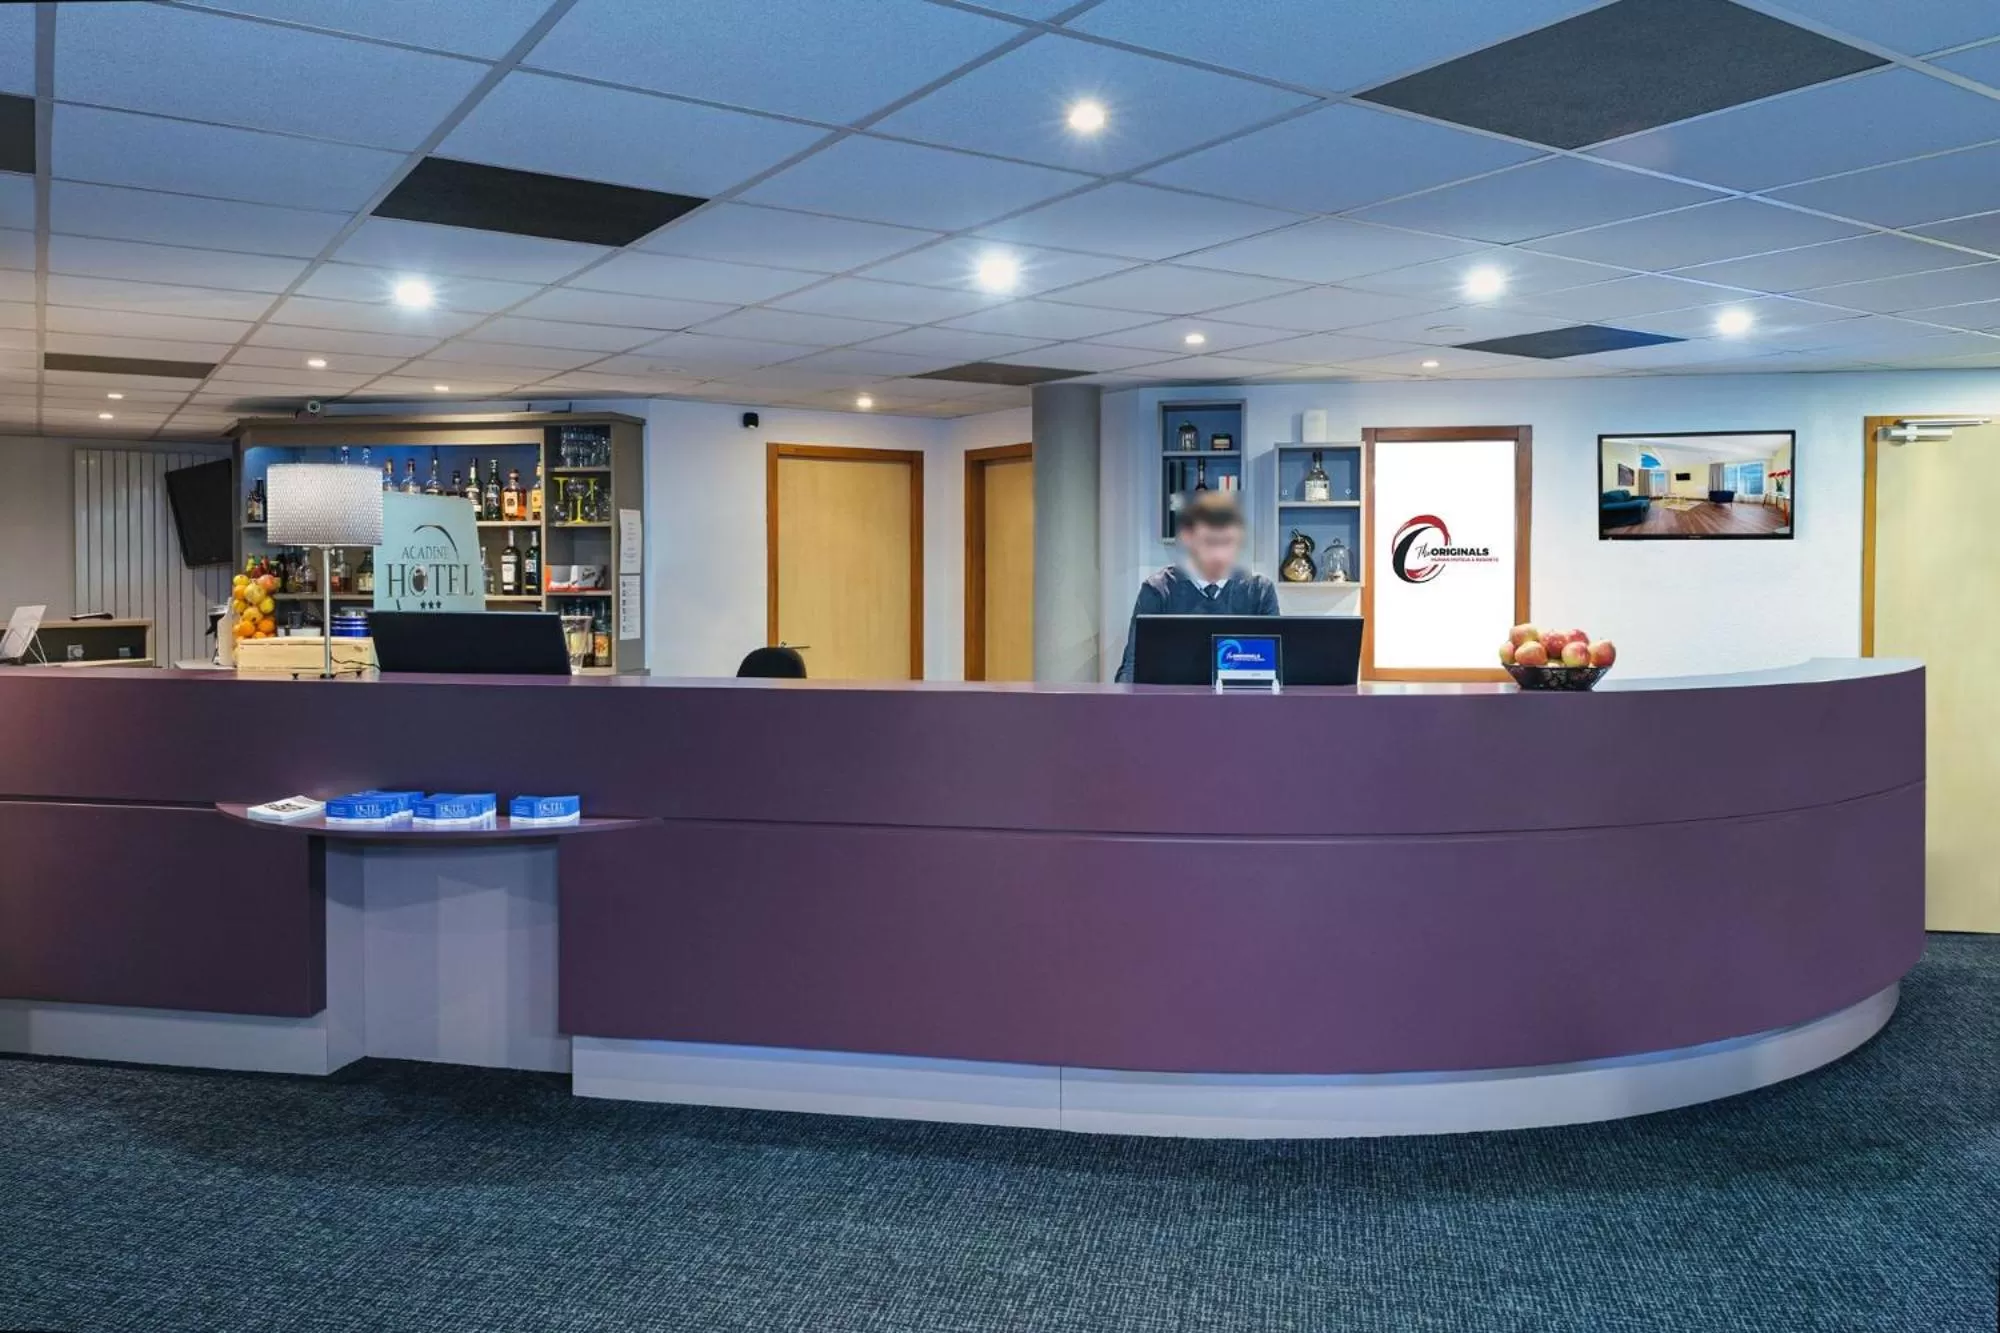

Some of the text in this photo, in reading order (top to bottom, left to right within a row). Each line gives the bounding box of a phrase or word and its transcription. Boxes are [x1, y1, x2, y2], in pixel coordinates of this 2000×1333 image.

[1415, 543, 1489, 559] The ORIGINALS
[384, 562, 475, 598] HOTEL
